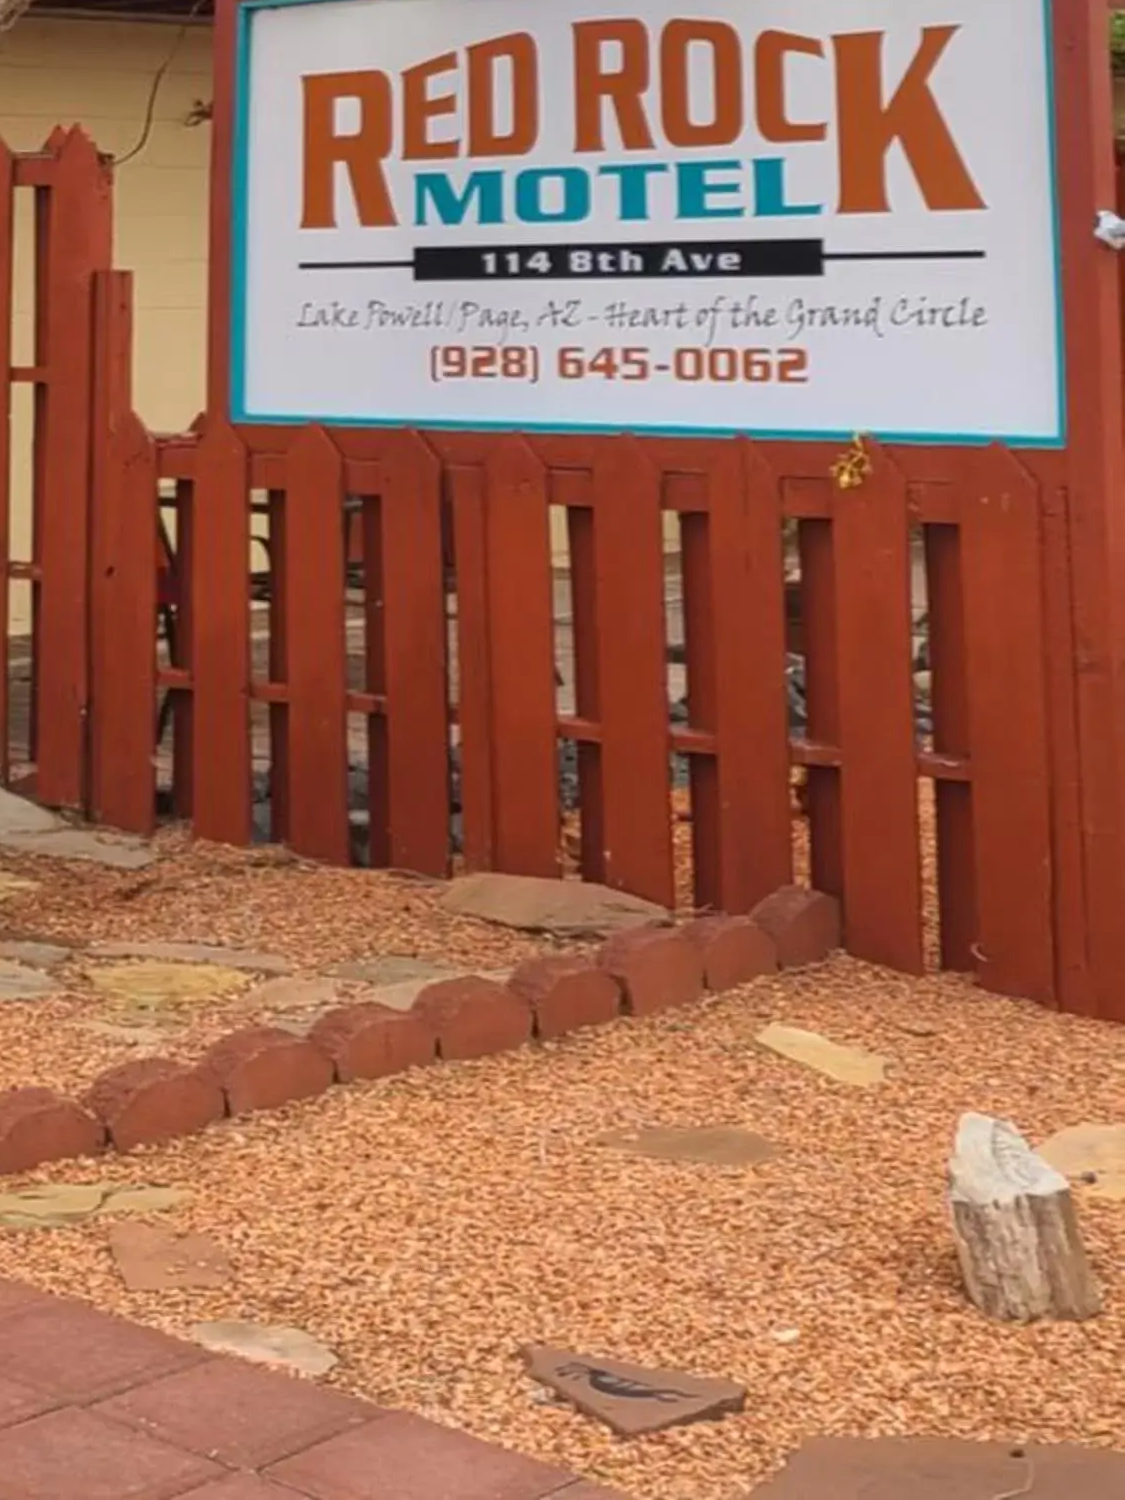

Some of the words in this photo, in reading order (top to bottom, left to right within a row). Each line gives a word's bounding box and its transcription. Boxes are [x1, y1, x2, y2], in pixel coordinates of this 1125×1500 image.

[299, 31, 539, 229] RED
[571, 17, 988, 215] ROCK
[413, 157, 824, 227] MOTEL
[481, 251, 552, 275] 114
[568, 249, 645, 273] 8th
[660, 248, 742, 272] Ave
[296, 301, 359, 328] Lake
[535, 298, 583, 328] AZ
[603, 301, 691, 328] Heart
[695, 295, 727, 347] of
[729, 295, 779, 328] the
[784, 297, 885, 341] Grand
[888, 296, 989, 328] Circle
[430, 345, 540, 384] (928)
[557, 346, 809, 383] 645-0062
